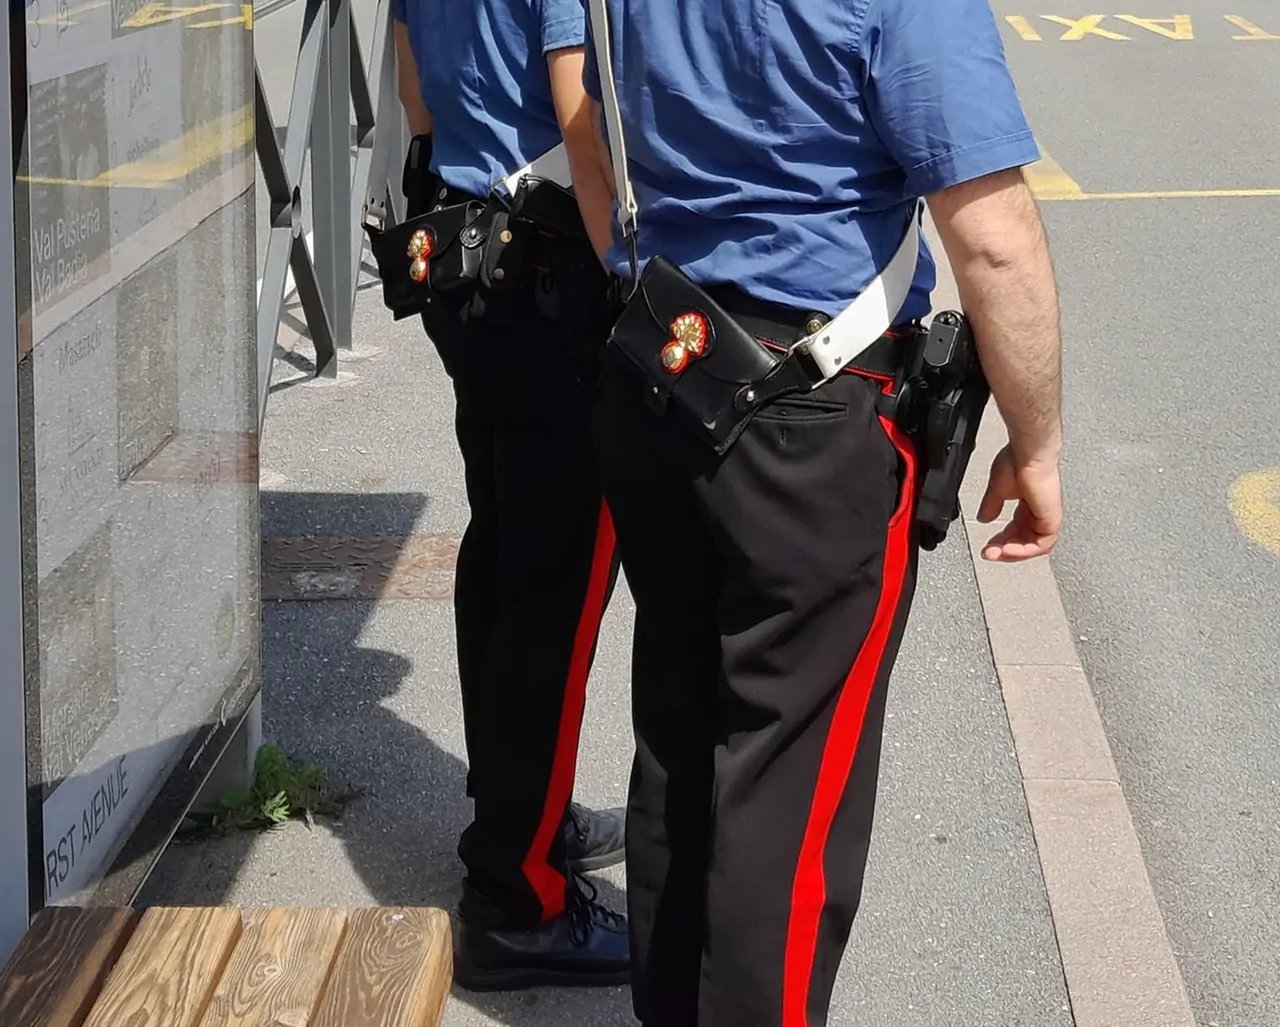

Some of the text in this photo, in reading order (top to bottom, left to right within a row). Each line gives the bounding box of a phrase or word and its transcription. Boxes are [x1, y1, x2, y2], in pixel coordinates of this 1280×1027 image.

[34, 208, 100, 263] Val Pusteria
[36, 251, 88, 305] Val Badia
[81, 754, 129, 856] AVENUE
